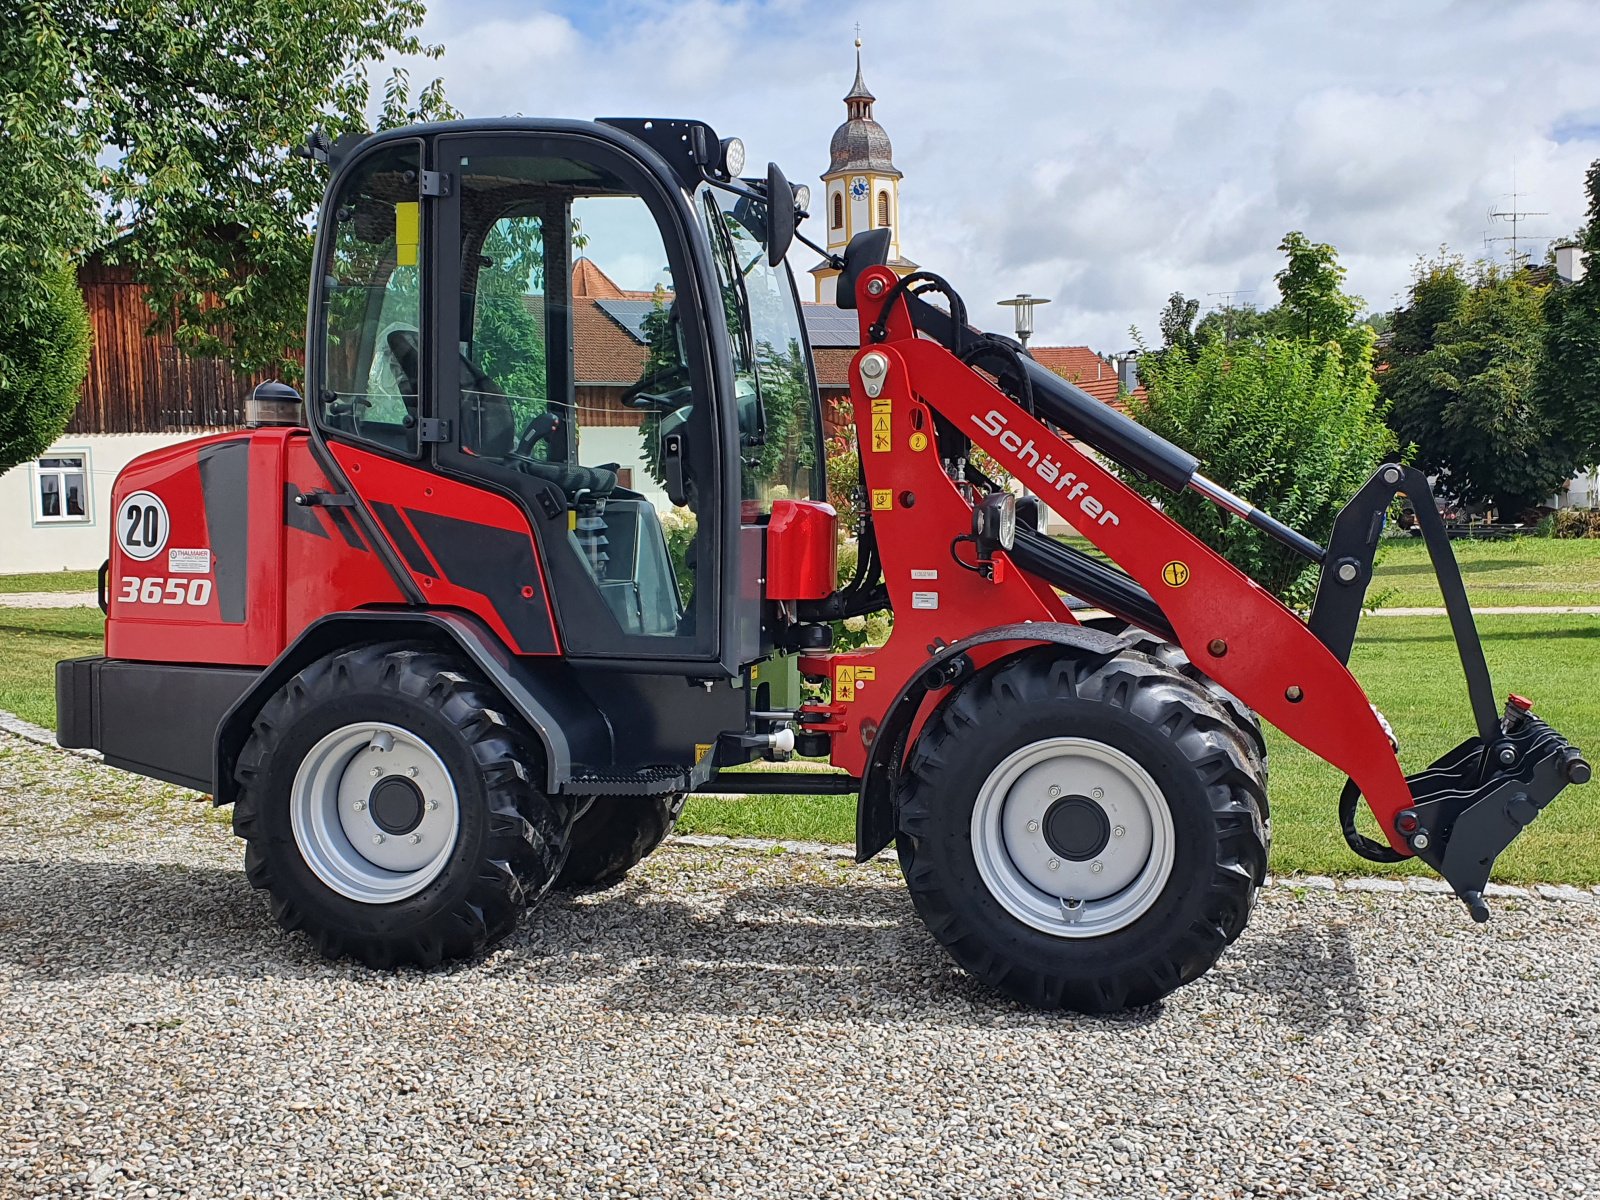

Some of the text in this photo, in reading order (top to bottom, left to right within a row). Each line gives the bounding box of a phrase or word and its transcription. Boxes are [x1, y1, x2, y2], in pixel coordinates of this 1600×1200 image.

[970, 410, 1120, 526] Schäffer
[126, 504, 159, 548] 20
[117, 576, 212, 606] 3650
